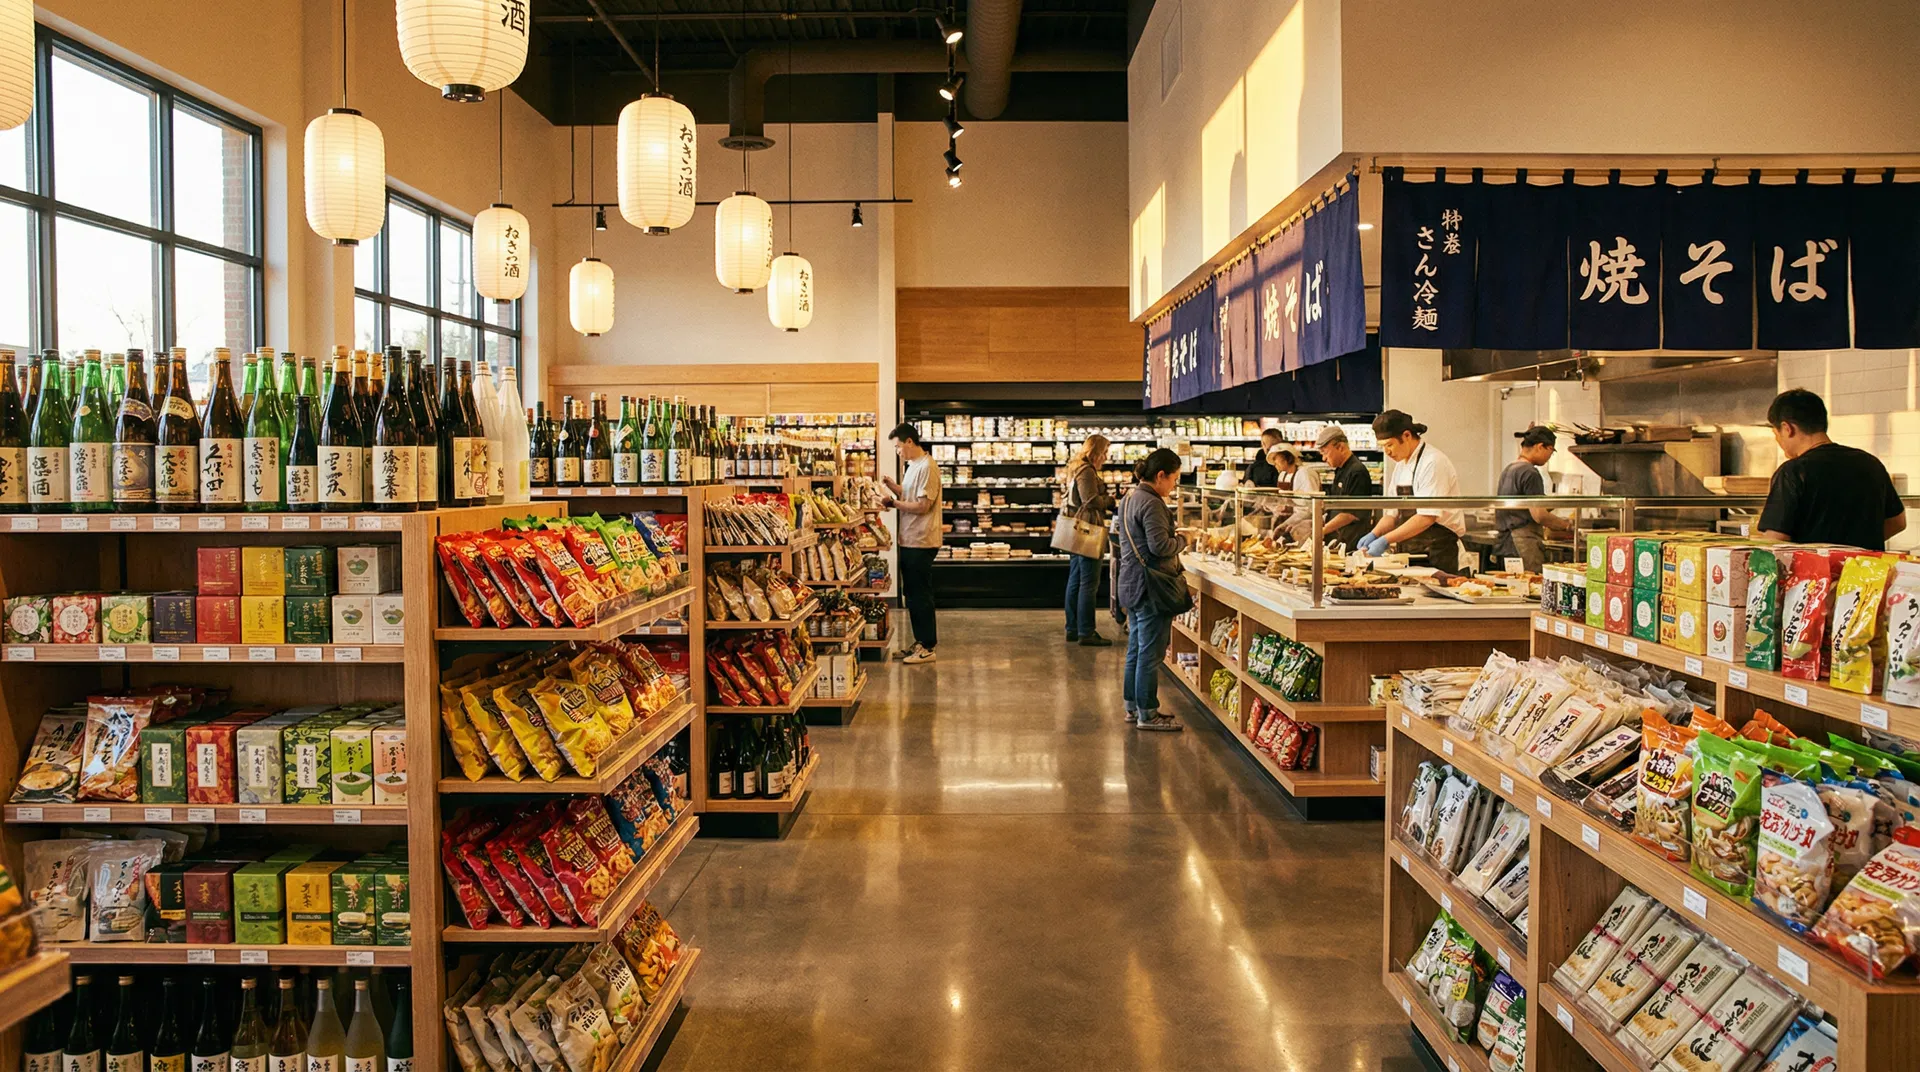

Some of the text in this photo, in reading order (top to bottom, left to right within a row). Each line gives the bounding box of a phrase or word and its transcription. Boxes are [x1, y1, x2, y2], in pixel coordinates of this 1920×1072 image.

[1264, 260, 1323, 341] 焼そば
[1412, 226, 1439, 331] さん冷麺
[1580, 236, 1838, 304] 焼そば
